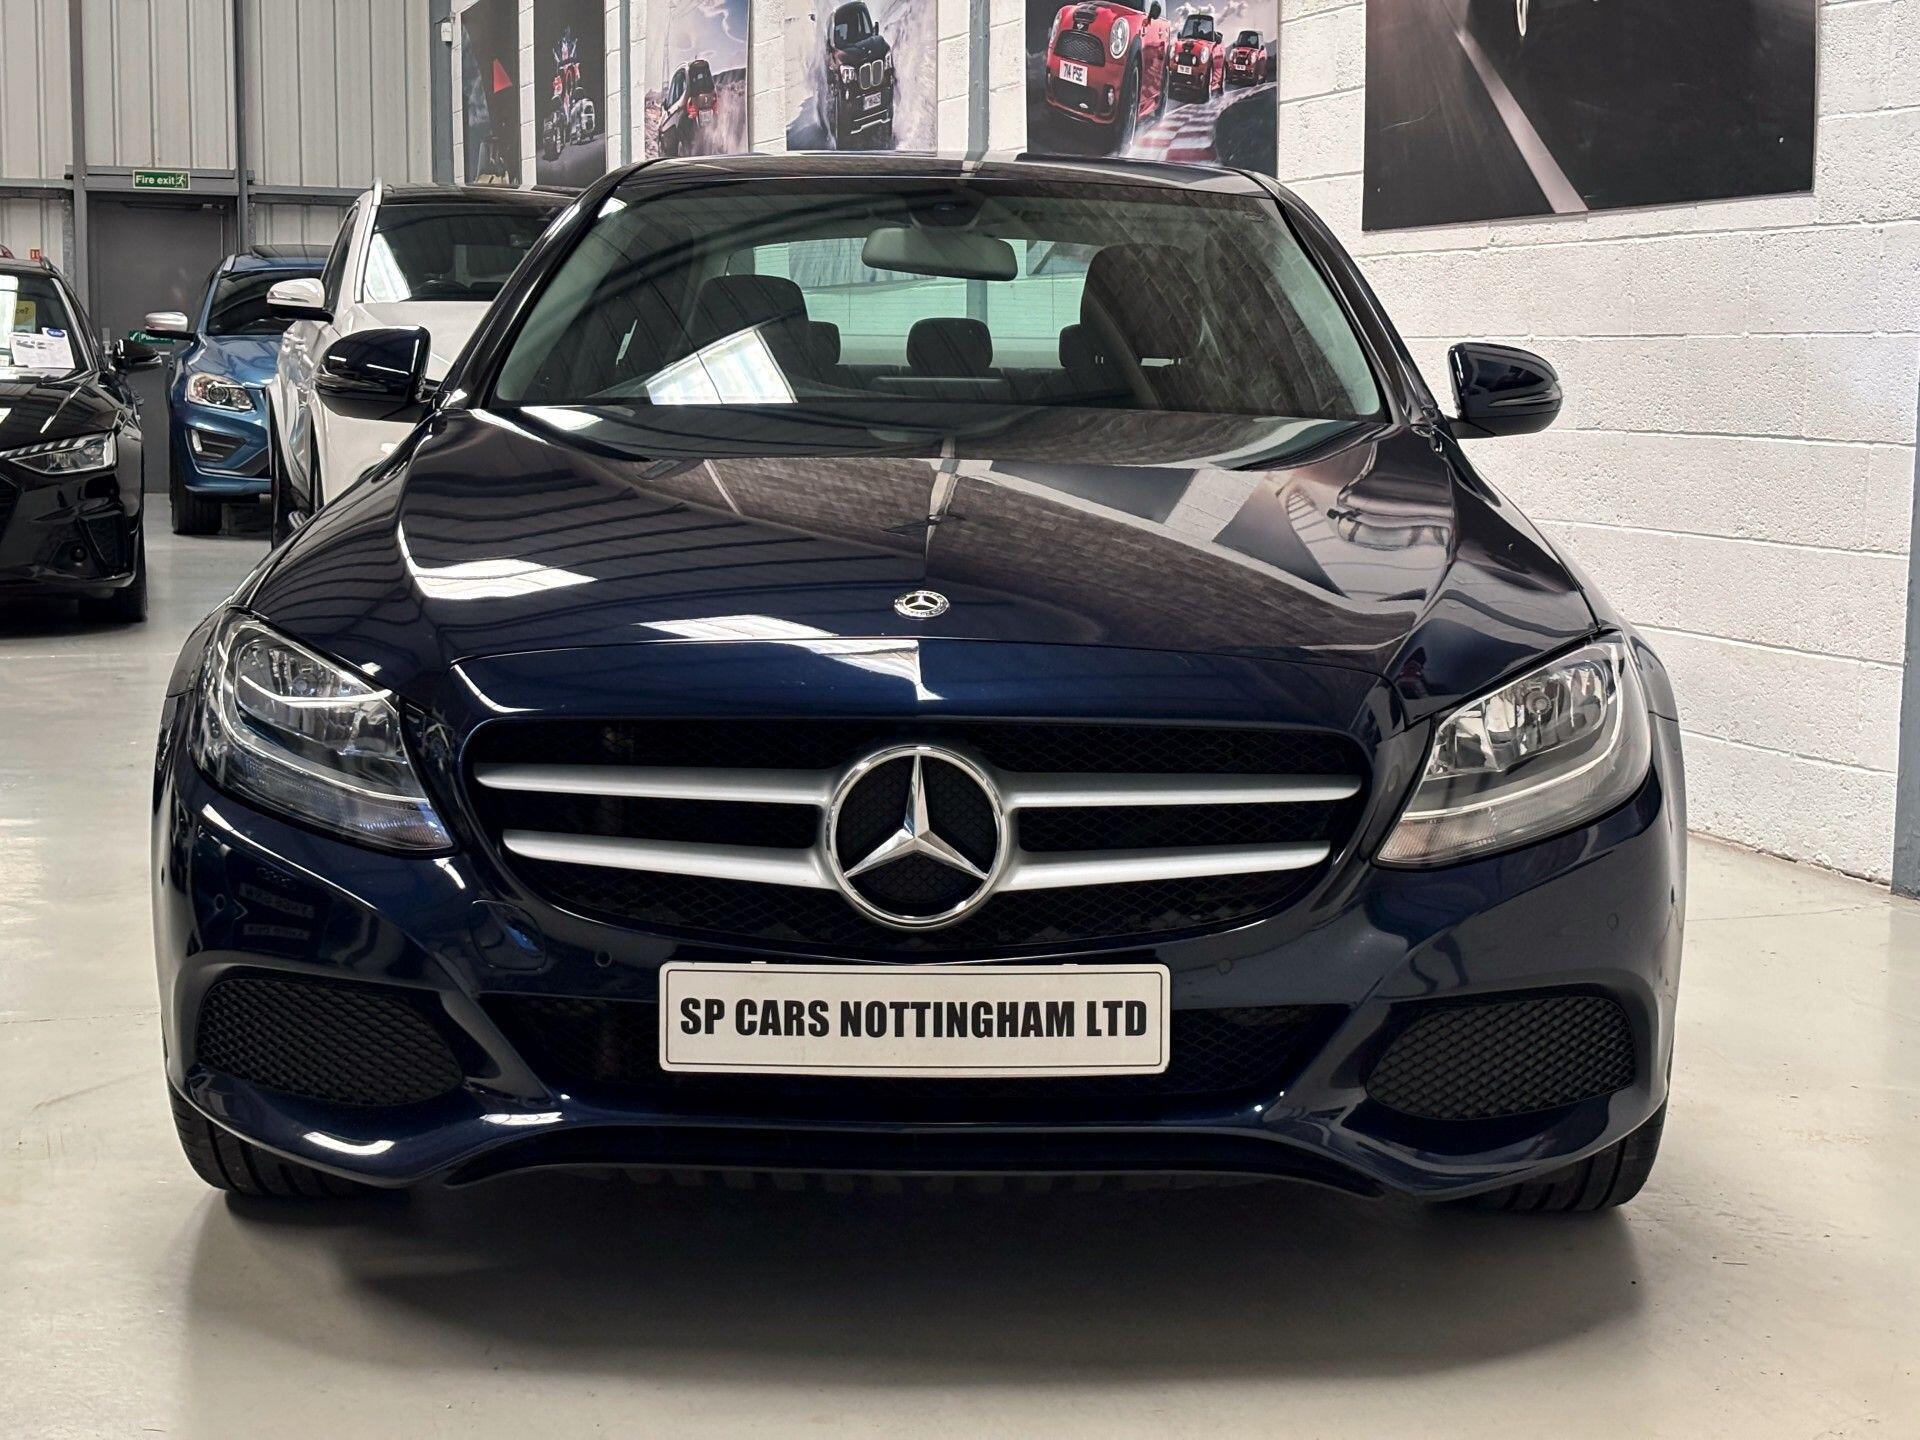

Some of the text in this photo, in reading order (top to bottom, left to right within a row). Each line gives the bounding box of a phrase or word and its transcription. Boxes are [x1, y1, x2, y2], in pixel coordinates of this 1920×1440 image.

[135, 174, 175, 185] Fire exit
[681, 998, 1147, 1038] SP CARS NOTTINGHAM LTD
